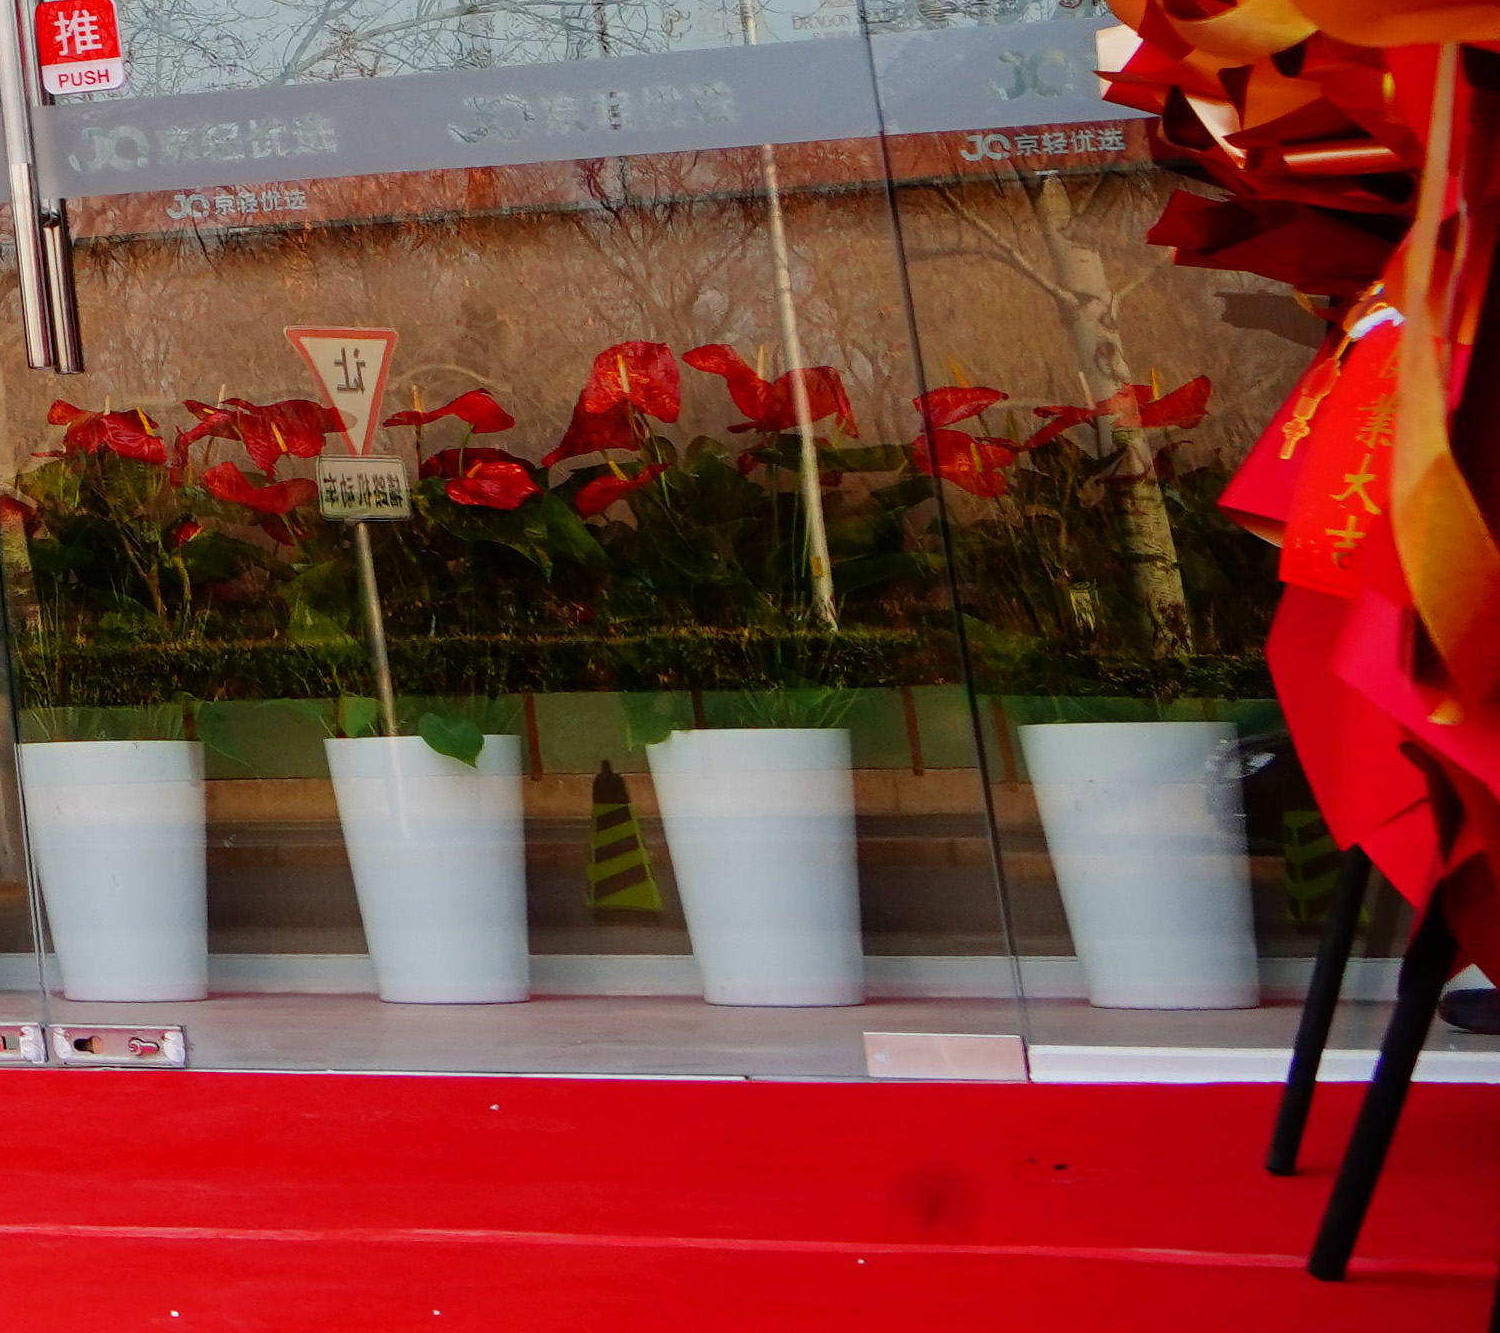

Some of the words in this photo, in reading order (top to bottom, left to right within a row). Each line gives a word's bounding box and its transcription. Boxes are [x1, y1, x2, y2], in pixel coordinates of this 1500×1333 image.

[54, 9, 103, 57] 推
[57, 68, 110, 89] PUSH
[1013, 128, 1127, 158] 京轻优选
[213, 189, 308, 215] 京轻优选
